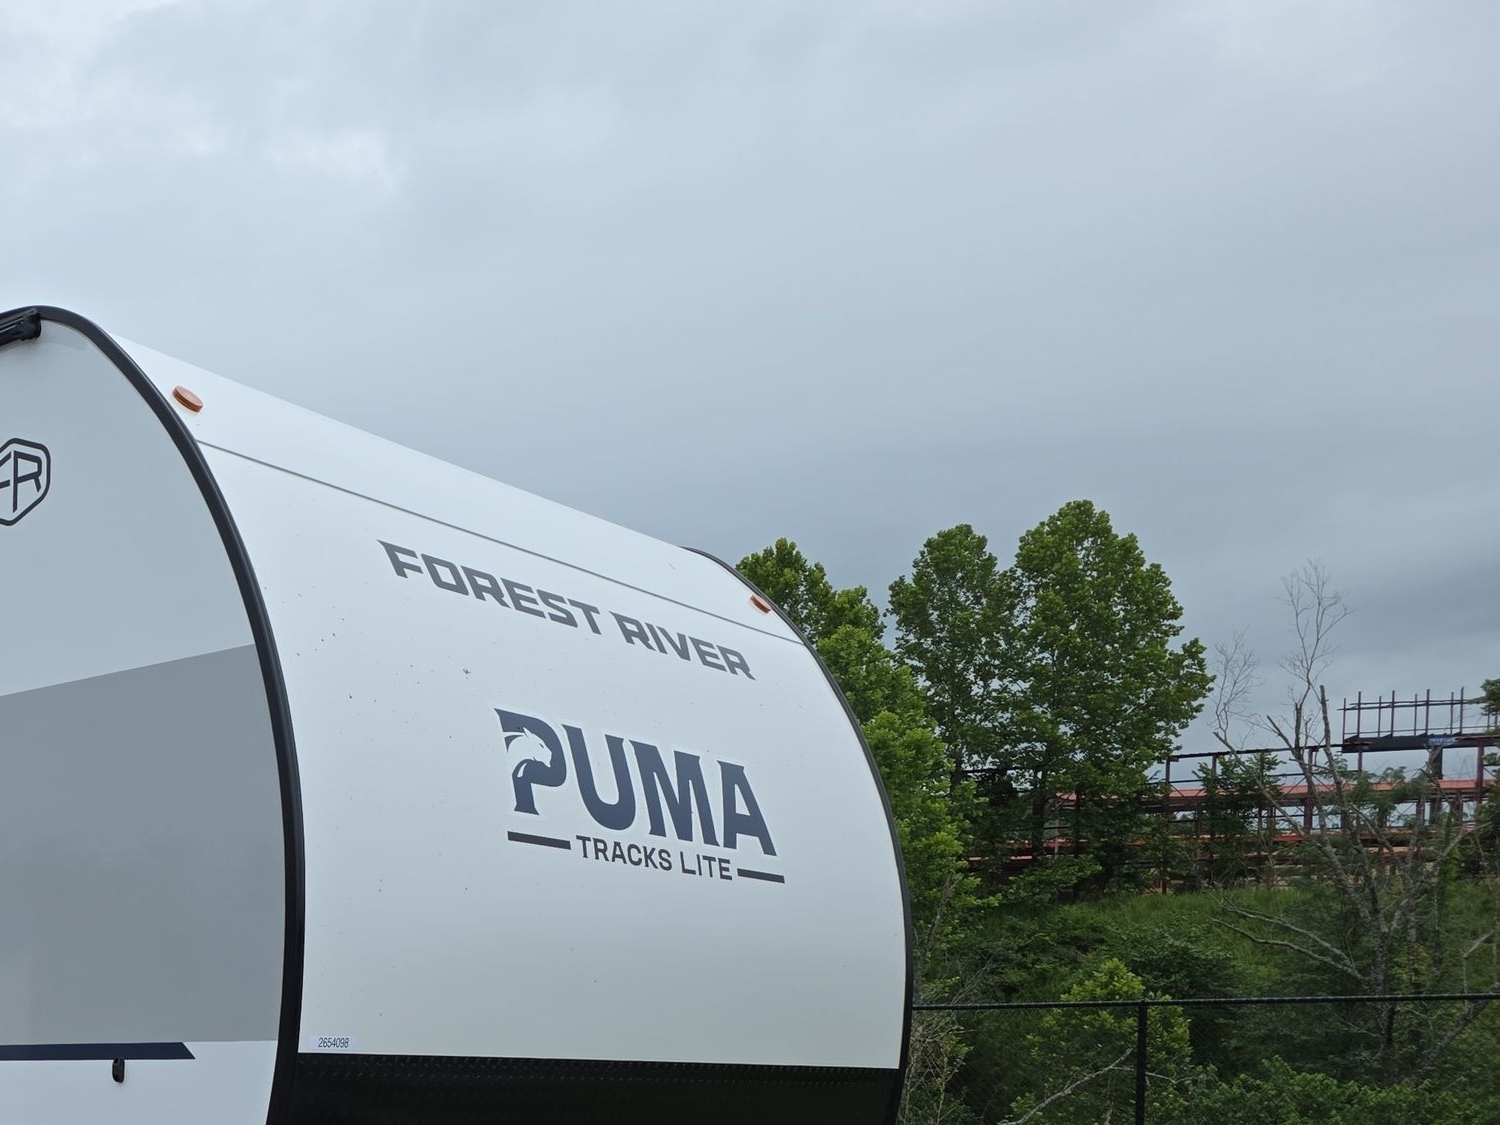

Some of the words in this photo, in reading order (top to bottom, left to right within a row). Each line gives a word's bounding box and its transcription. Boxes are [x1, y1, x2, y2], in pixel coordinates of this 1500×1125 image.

[377, 539, 602, 635] FOREST
[608, 610, 756, 681] RIVER
[493, 707, 777, 856] PUMA
[575, 835, 673, 871] TRACKS
[679, 851, 733, 881] LITE
